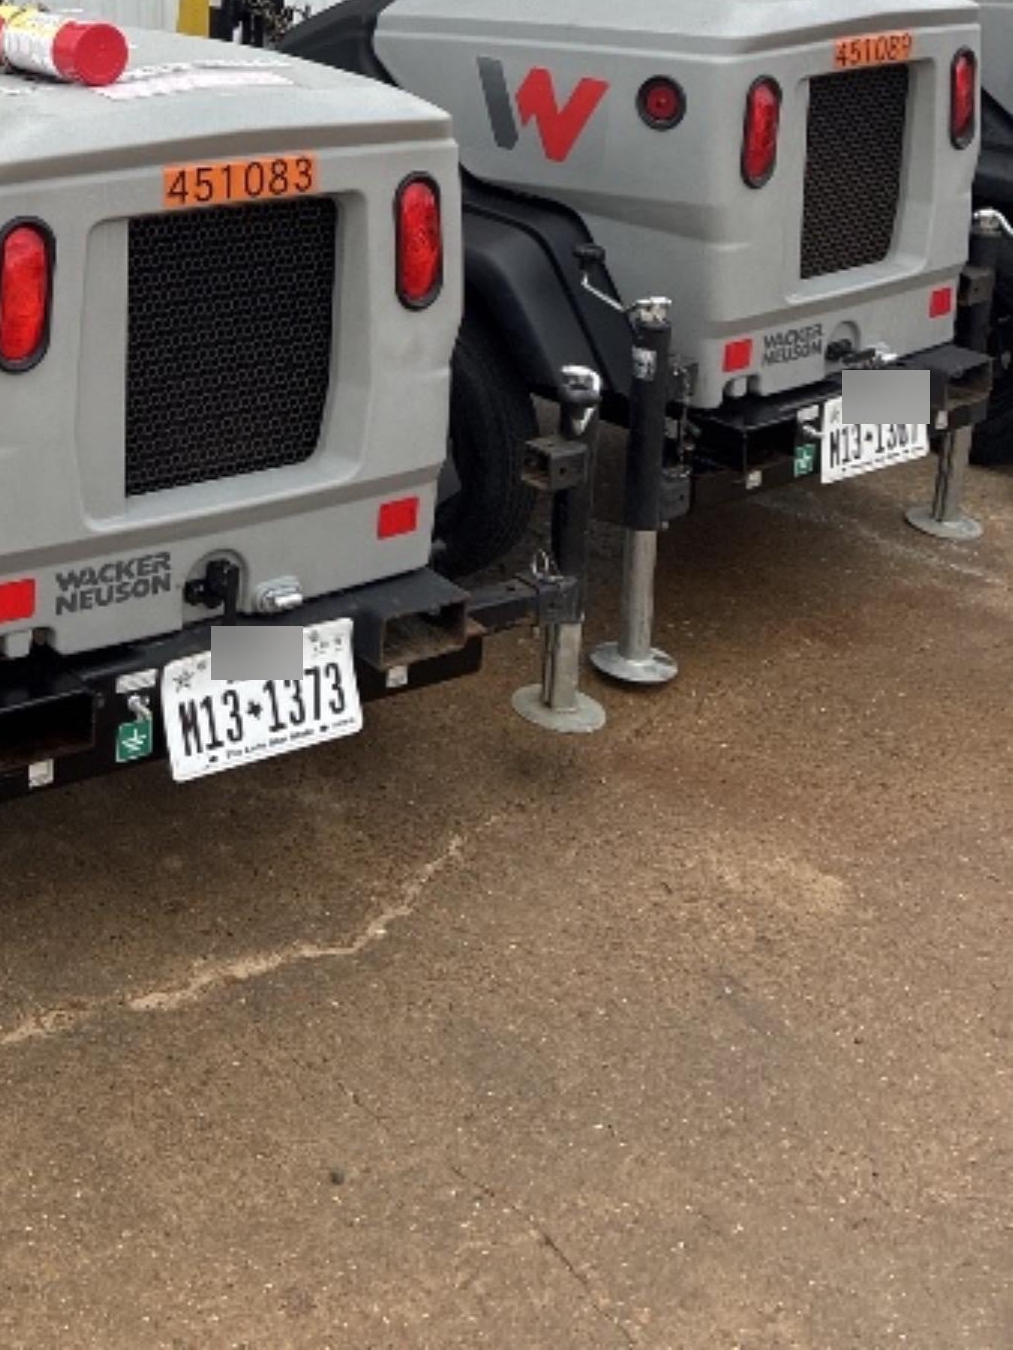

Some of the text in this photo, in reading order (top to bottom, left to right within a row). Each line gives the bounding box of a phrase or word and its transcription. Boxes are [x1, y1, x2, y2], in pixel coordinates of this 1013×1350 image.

[167, 156, 313, 204] 451083
[55, 551, 172, 592] WACKER
[54, 572, 172, 616] NEUSON
